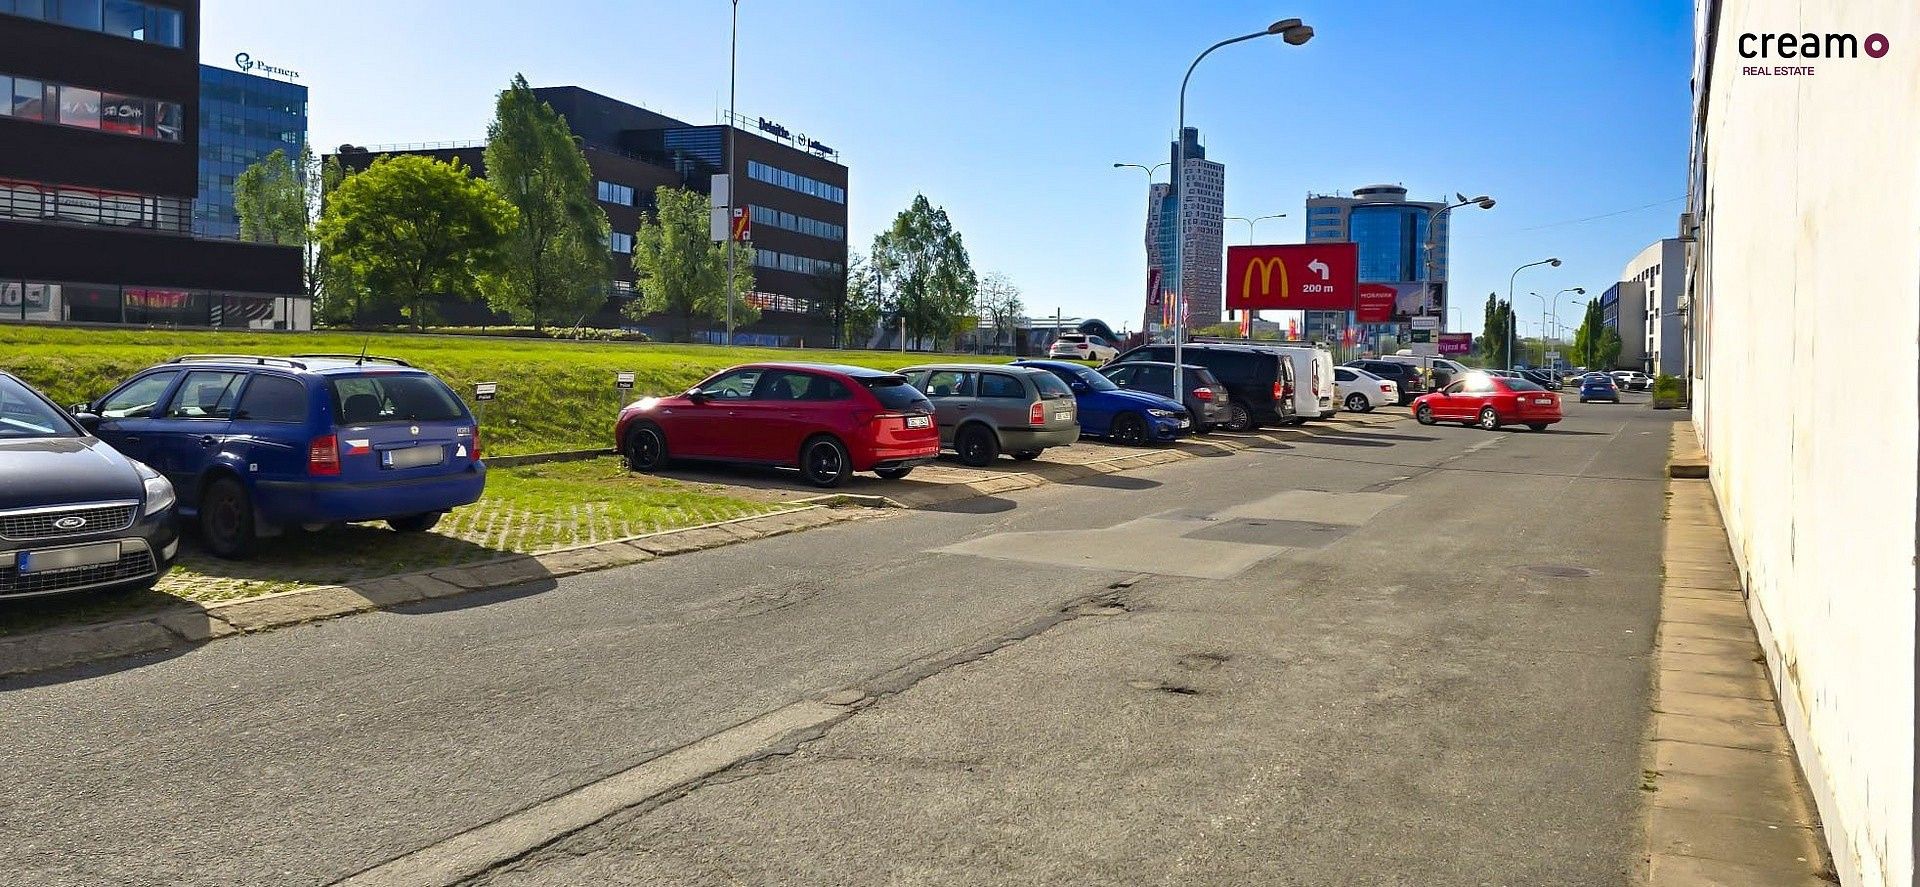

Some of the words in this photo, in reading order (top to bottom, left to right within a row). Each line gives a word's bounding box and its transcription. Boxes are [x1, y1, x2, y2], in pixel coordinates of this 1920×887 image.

[257, 60, 300, 78] Partners
[1302, 284, 1322, 293] 200
[1323, 285, 1333, 293] m
